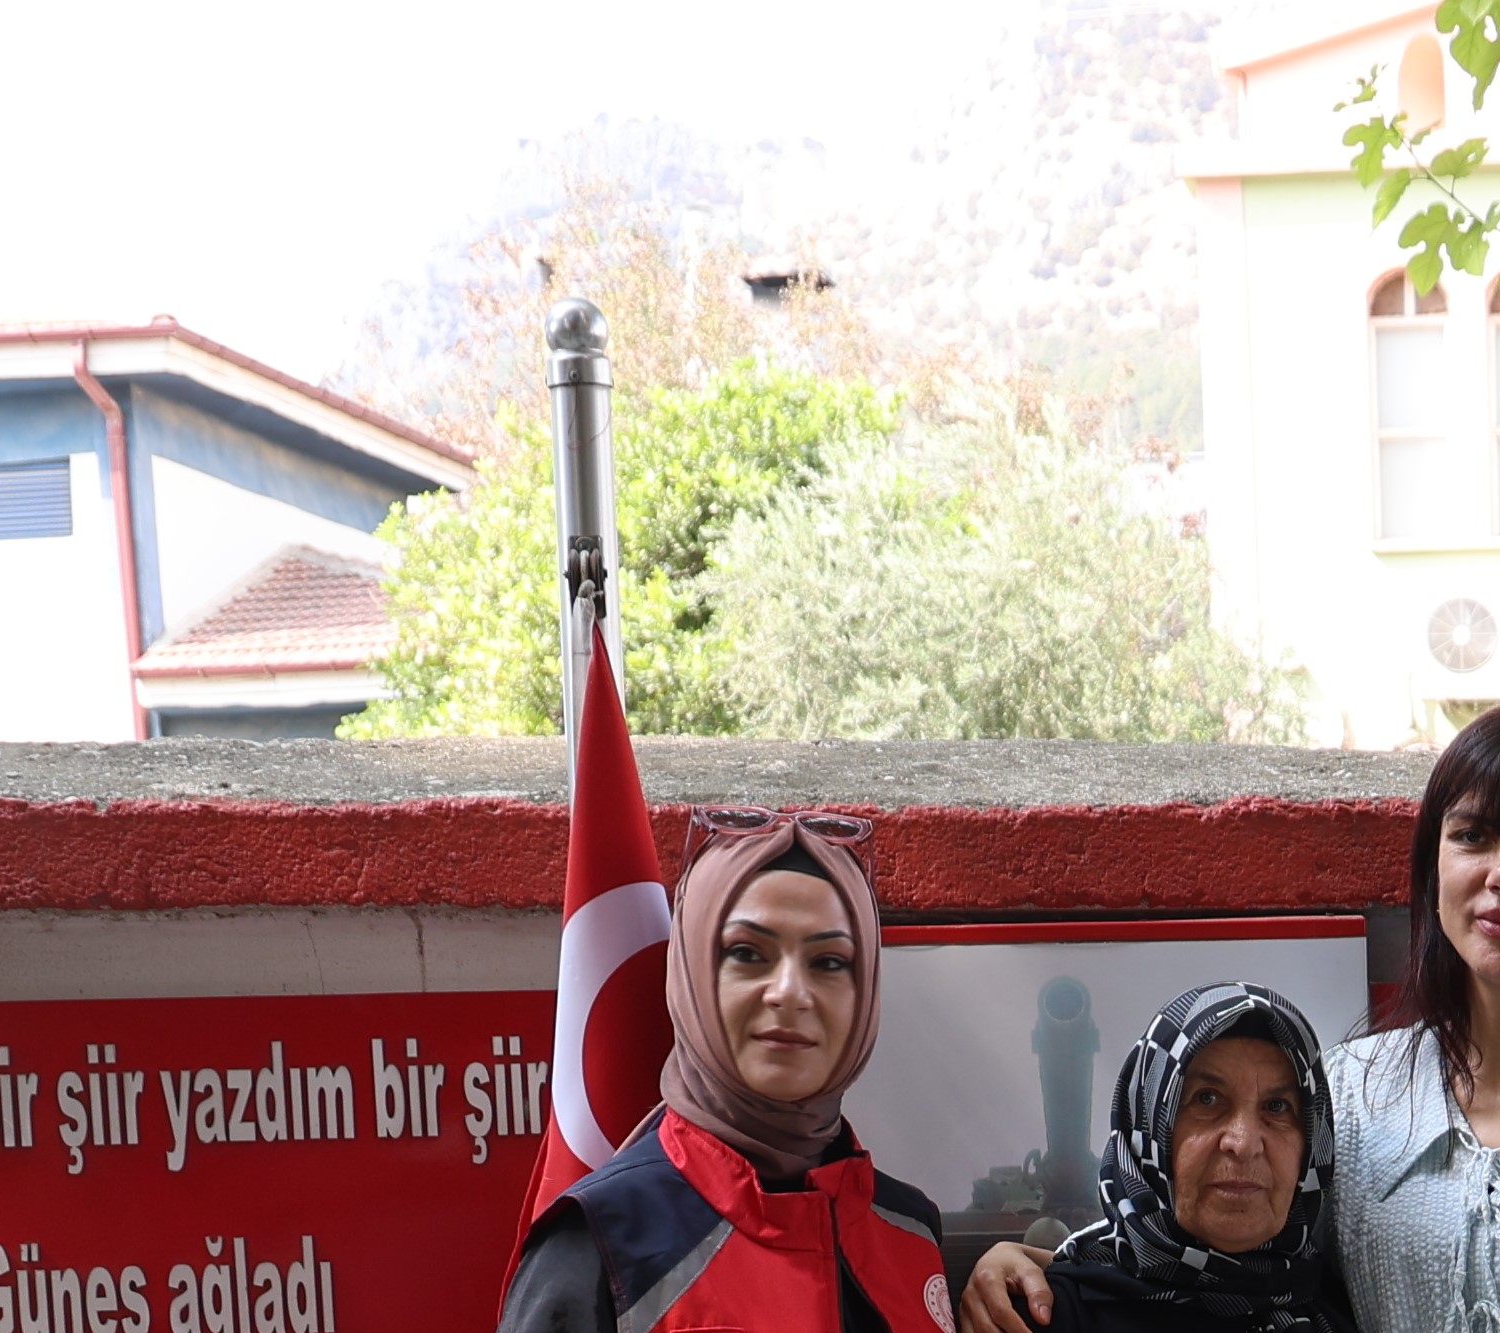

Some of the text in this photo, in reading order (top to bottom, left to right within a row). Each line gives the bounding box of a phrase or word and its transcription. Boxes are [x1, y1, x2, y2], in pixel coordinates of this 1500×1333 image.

[57, 1042, 145, 1175] şiir
[160, 1040, 356, 1172] yazdım
[371, 1037, 445, 1140] bir
[463, 1035, 549, 1165] şiir
